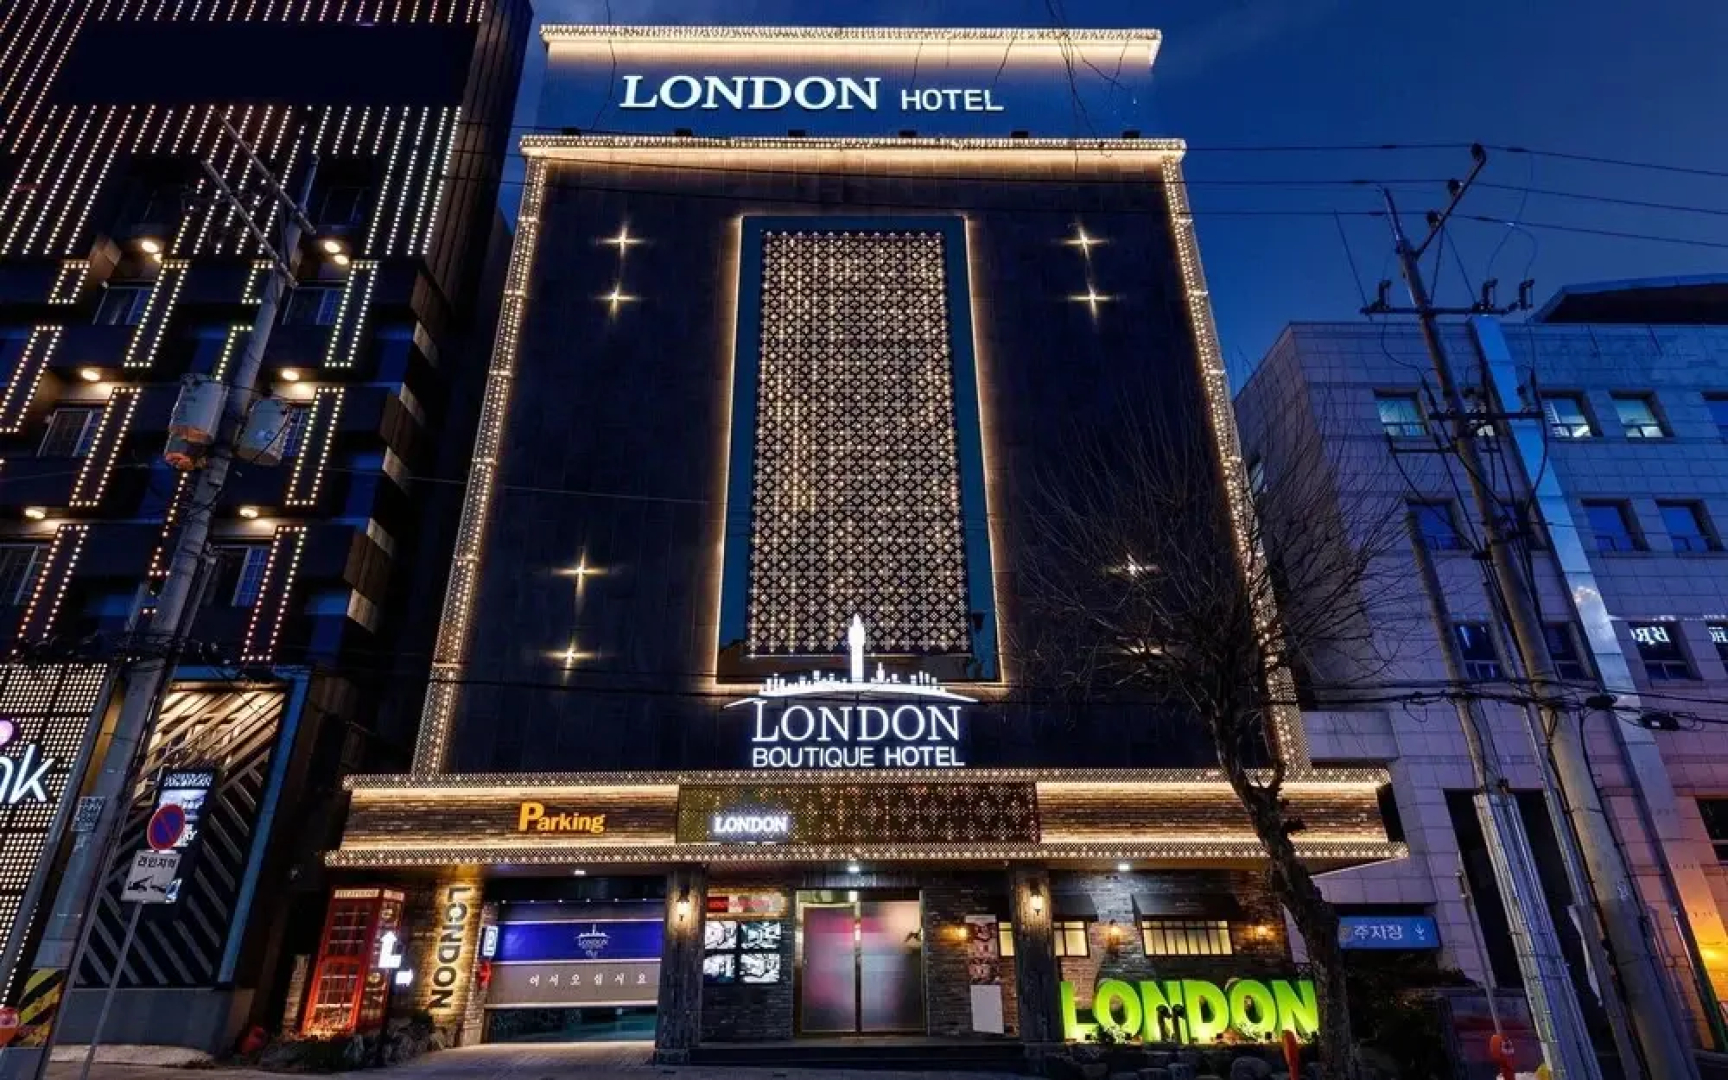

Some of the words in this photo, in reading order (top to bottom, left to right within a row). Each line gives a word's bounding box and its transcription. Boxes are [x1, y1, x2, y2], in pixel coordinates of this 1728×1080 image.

[619, 75, 880, 110] LONDON
[901, 89, 1004, 112] HOTEL
[752, 700, 962, 742] LONDON
[752, 747, 875, 768] BOUTIQUE
[884, 746, 965, 767] HOTEL
[518, 801, 607, 834] Parking
[713, 815, 789, 833] LONDON
[430, 887, 470, 1007] LONDON
[1061, 979, 1319, 1043] LONDON
